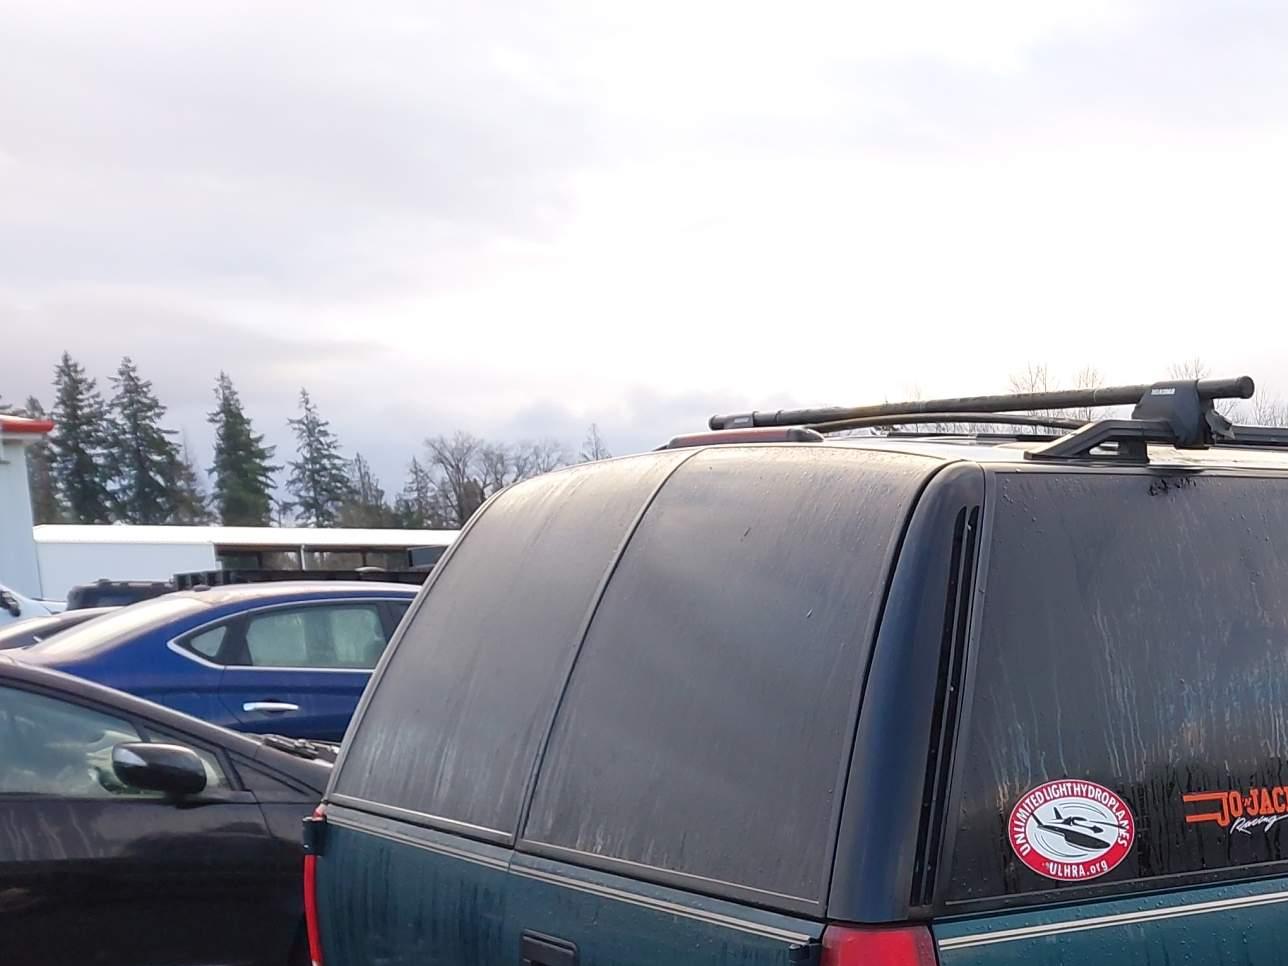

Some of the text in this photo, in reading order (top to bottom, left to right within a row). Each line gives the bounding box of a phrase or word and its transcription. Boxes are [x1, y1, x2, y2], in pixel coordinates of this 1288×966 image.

[1013, 782, 1130, 856] UNLIMITED LIGHT HYDROPLANES
